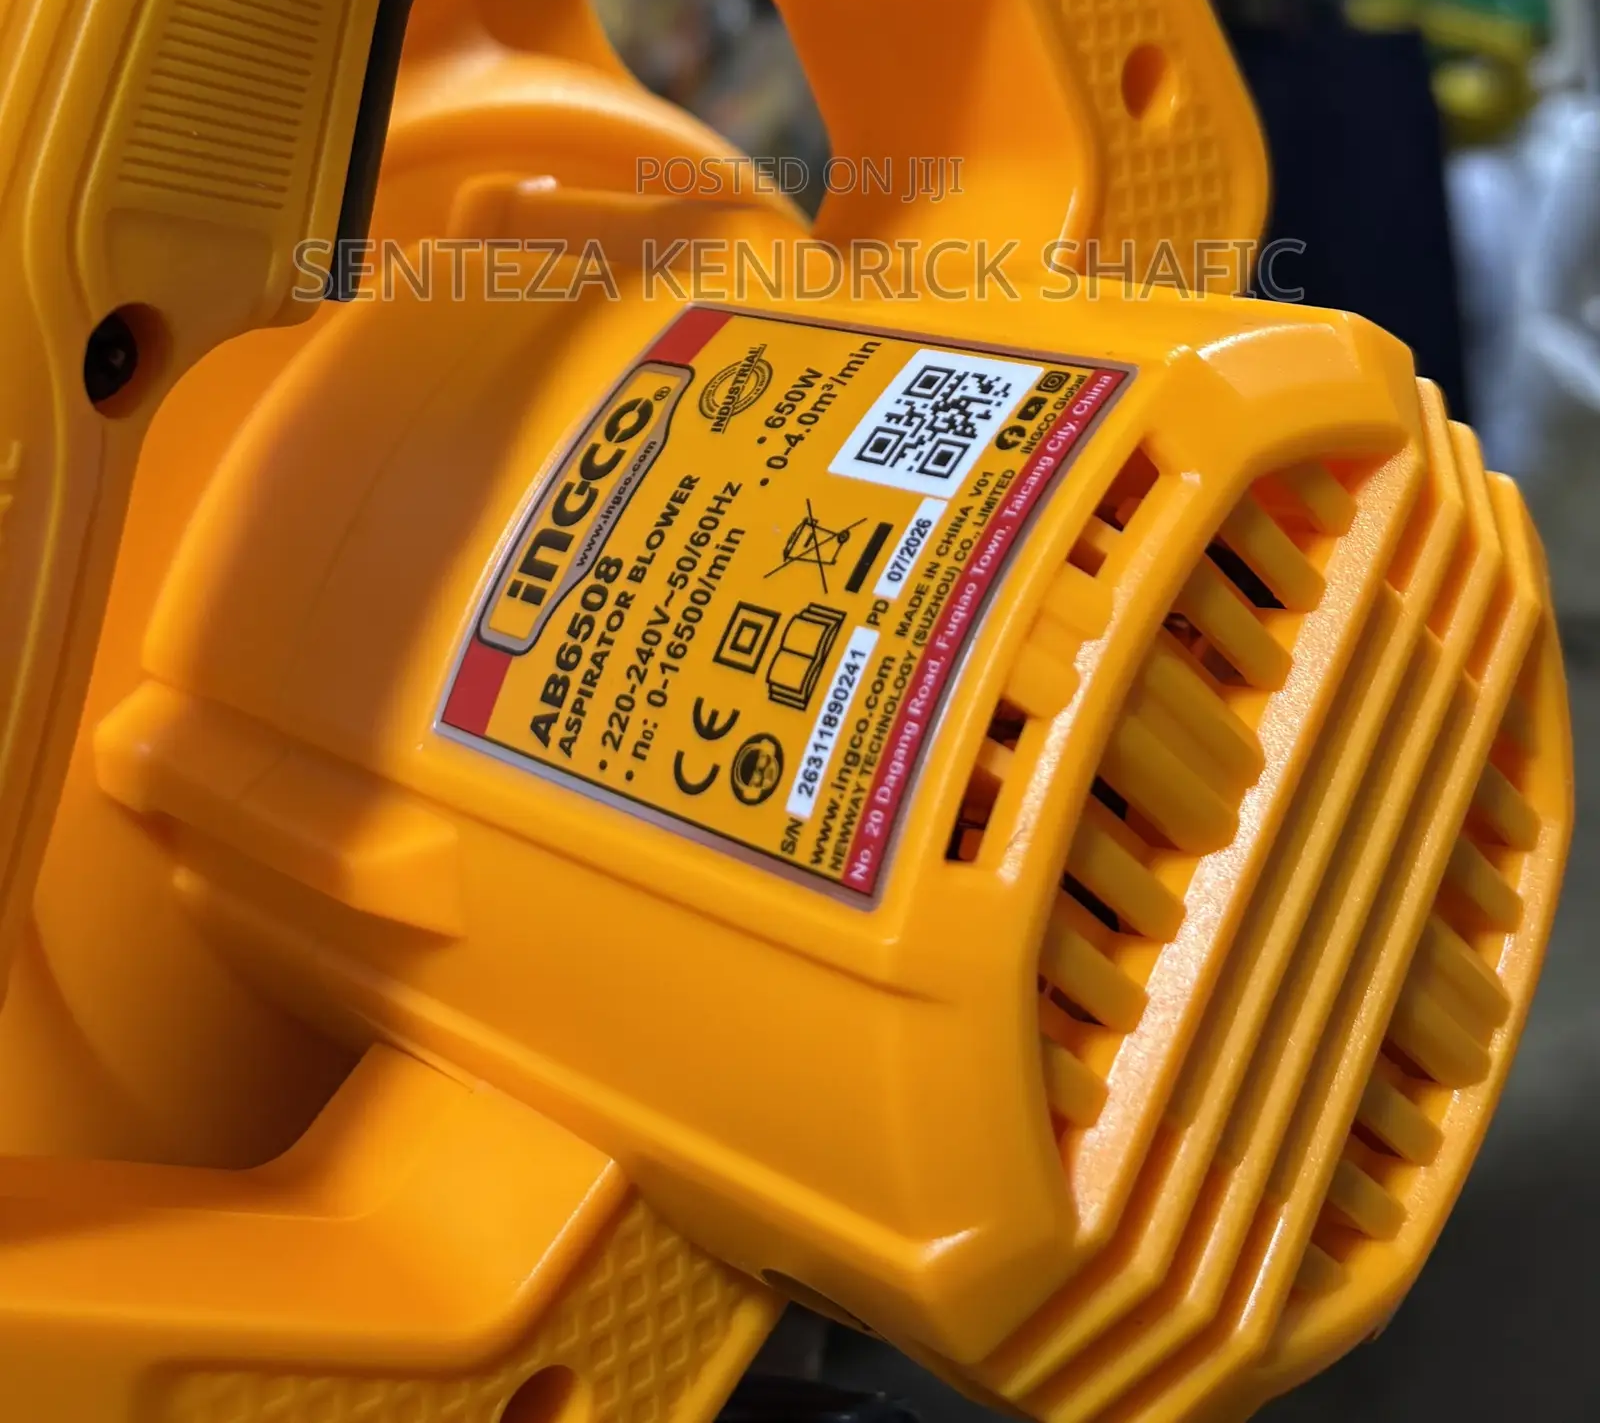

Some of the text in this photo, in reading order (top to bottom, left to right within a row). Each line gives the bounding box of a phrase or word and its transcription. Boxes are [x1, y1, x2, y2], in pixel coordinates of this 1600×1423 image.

[710, 345, 762, 434] INDUSTRIAL
[764, 367, 824, 429] 650W
[1020, 374, 1088, 454] INGCO Global
[575, 440, 657, 568] www.ingco.com
[895, 470, 995, 638] MADE IN CHINA V01
[530, 555, 624, 748] AB6508
[558, 474, 701, 759] ASPIRATOR BLOWER
[646, 527, 746, 708] 0-16500/min
[780, 518, 932, 855] S/N 26311890241 PD 07/2026
[828, 781, 867, 871] NEWWAY
[859, 650, 917, 779] TECHNOLOGY
[912, 565, 962, 647] (SUZHOU)
[972, 469, 1016, 528] LIMITED
[850, 843, 874, 880] No.
[865, 809, 885, 838] 20
[875, 720, 919, 804] Dagang
[907, 655, 945, 715] Road,
[935, 582, 978, 650] Fuqiao
[1002, 455, 1055, 518] Taicang
[1072, 374, 1113, 416] China
[810, 655, 896, 866] www.ingco.com
